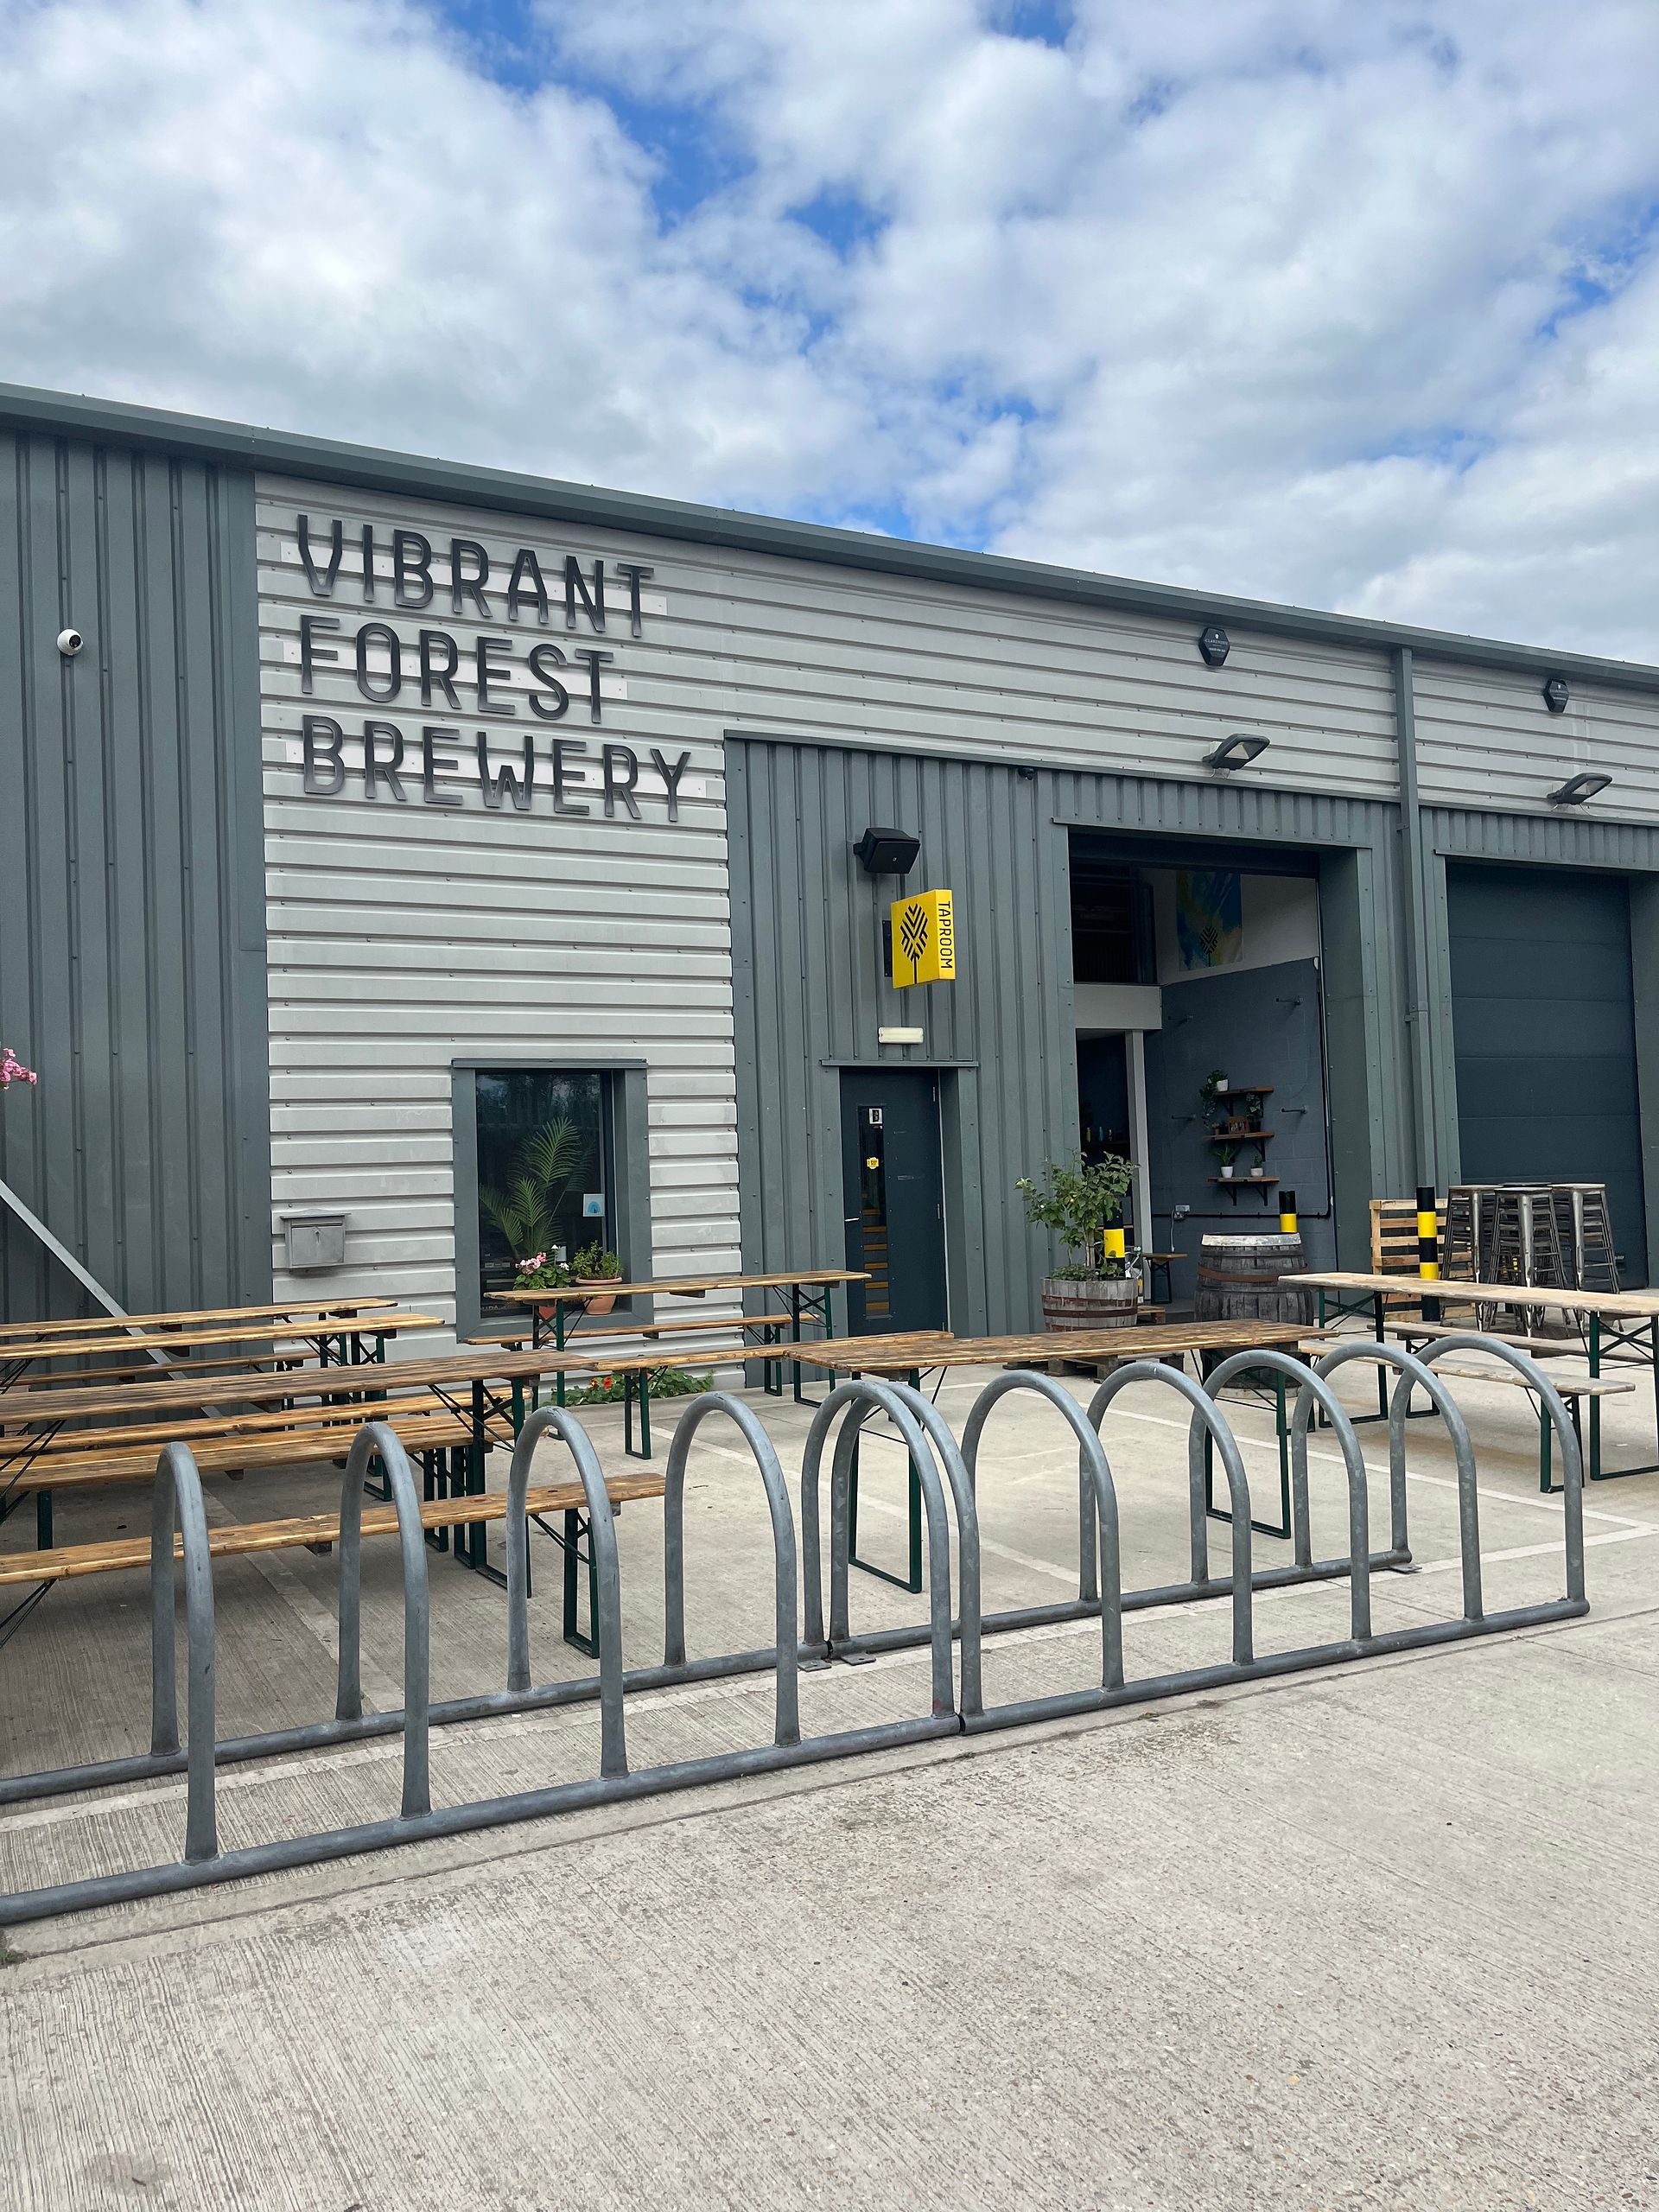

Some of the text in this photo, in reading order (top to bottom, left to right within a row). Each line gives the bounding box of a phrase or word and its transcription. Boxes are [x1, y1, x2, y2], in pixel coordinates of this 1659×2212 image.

[297, 514, 654, 638] VIBRANT
[301, 614, 613, 723] FOREST
[302, 715, 691, 822] BREWERY
[938, 900, 953, 969] TAPROOM
